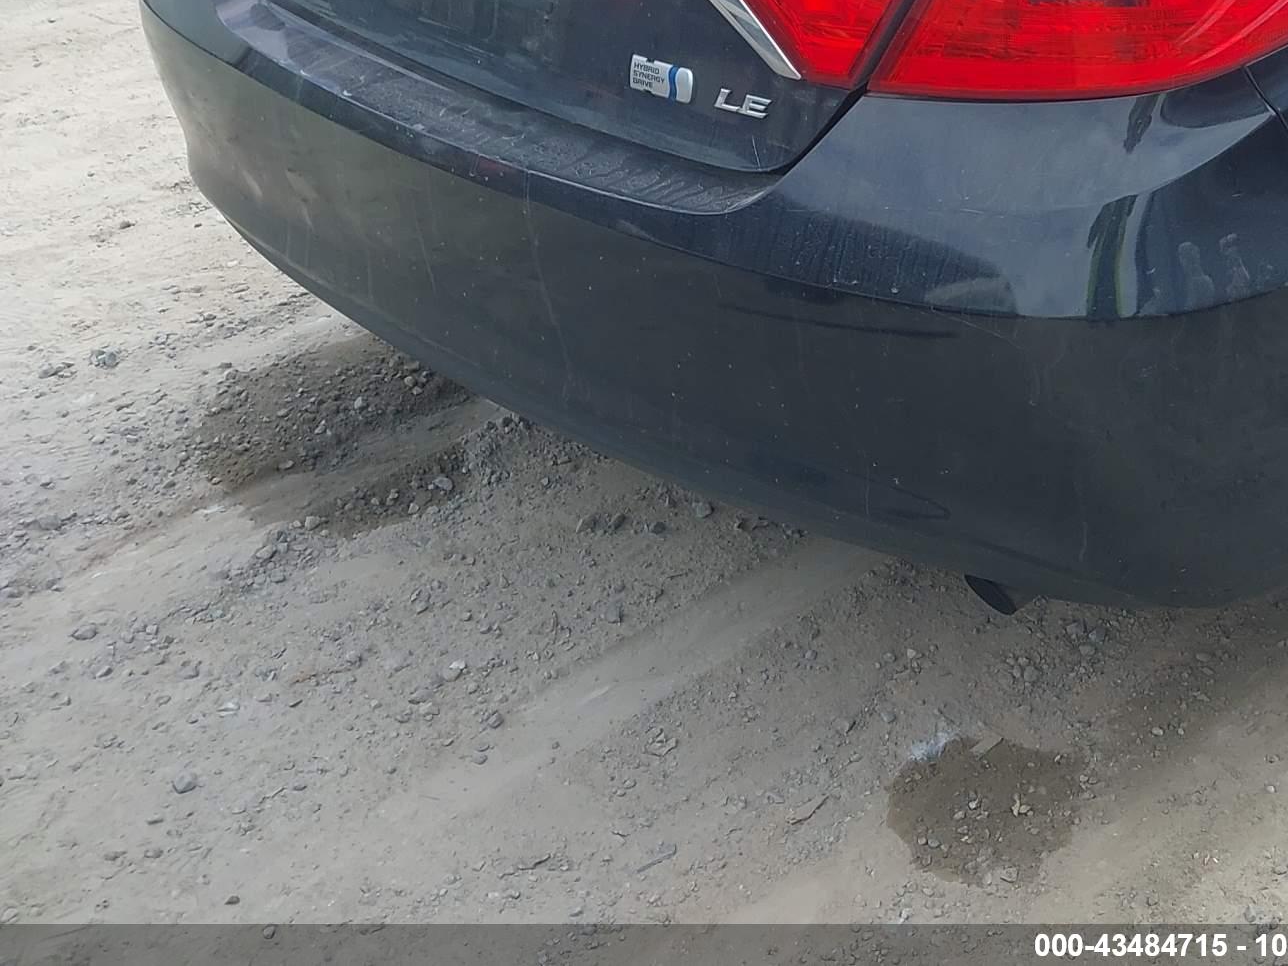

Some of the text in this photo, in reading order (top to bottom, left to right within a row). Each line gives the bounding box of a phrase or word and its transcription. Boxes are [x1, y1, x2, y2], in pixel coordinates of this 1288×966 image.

[633, 62, 660, 75] HYBRID
[632, 77, 653, 89] DRIVE
[633, 69, 666, 84] SYNERGY
[714, 88, 773, 119] LE
